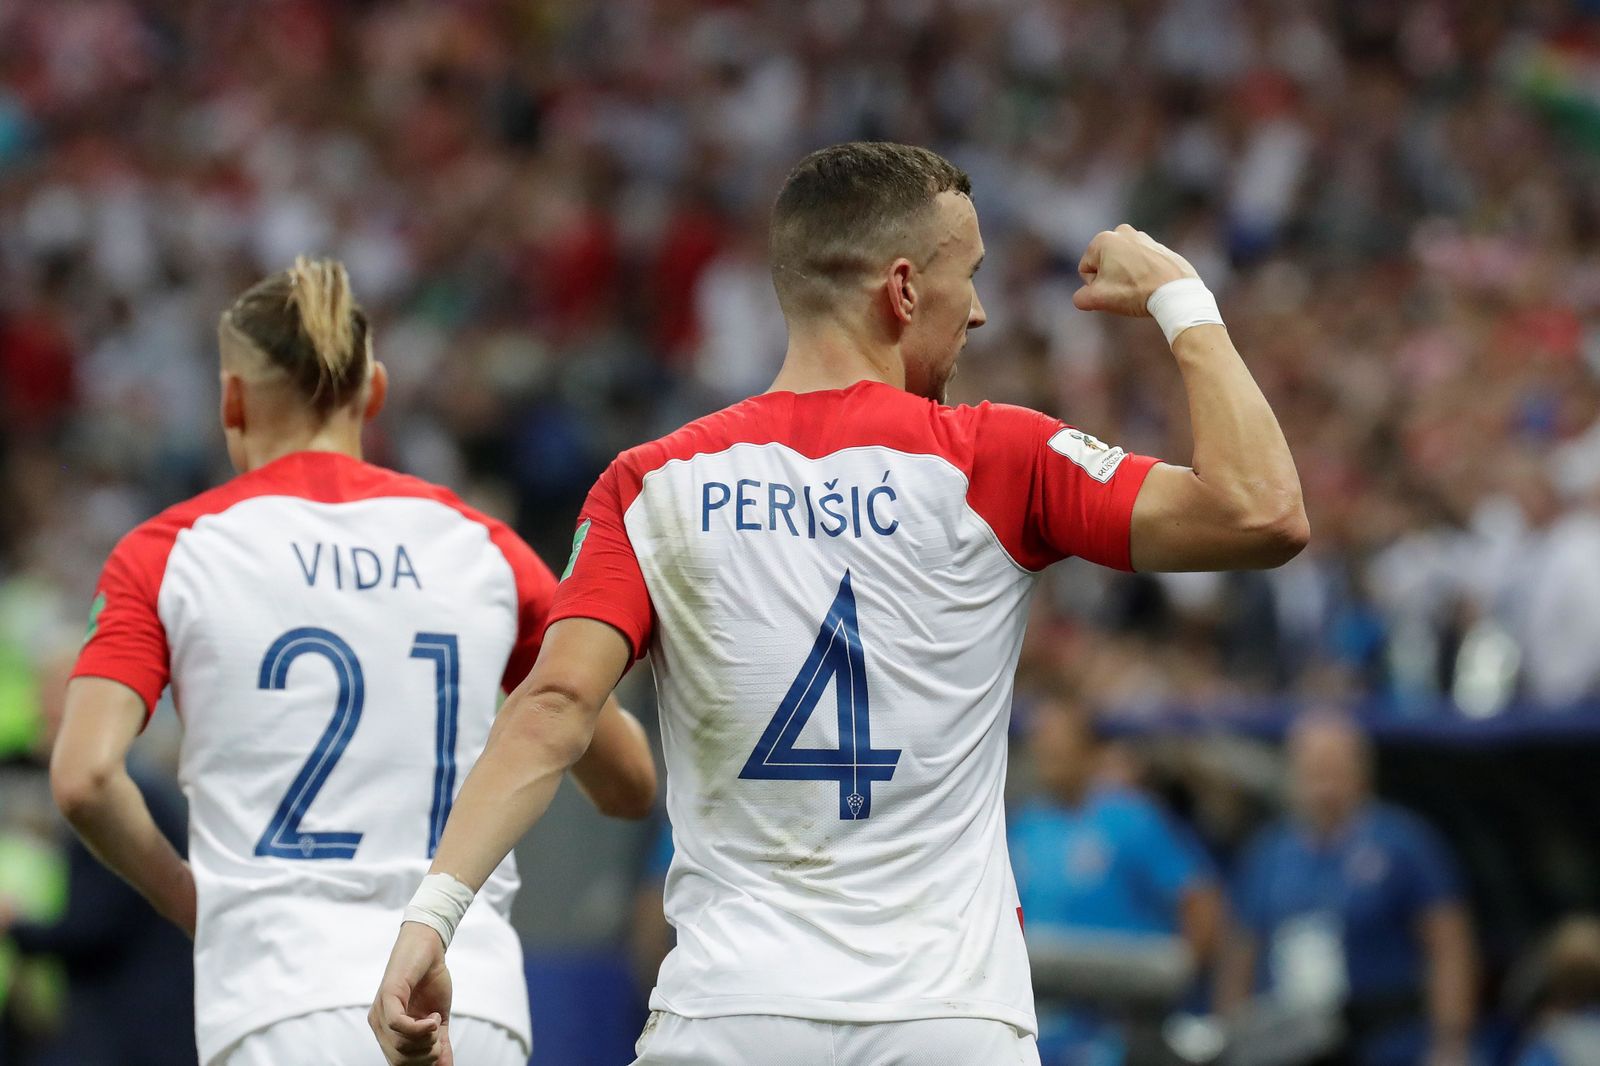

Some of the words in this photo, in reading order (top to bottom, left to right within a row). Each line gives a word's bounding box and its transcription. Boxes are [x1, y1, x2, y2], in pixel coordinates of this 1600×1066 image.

[291, 542, 422, 590] VIDA
[702, 470, 899, 539] PERIŠIĆ
[254, 626, 460, 860] 21
[739, 569, 902, 821] 4
